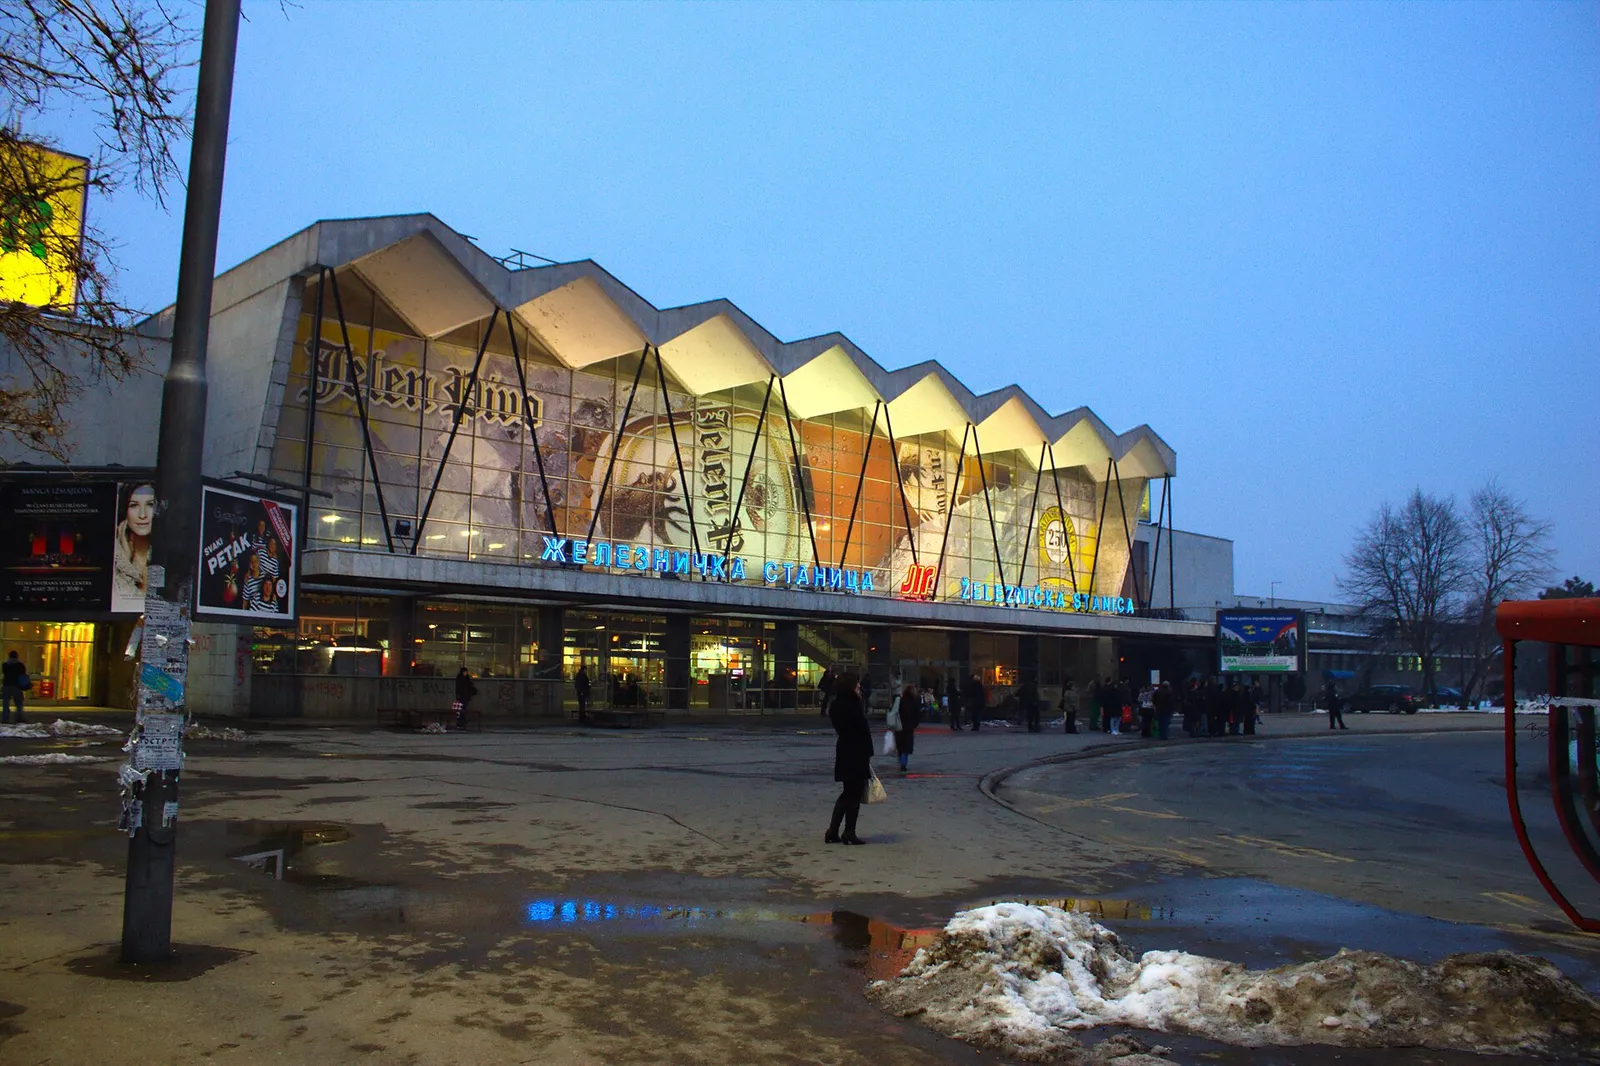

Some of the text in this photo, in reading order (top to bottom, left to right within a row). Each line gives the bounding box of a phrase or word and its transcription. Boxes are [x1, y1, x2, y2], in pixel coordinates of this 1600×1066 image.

[297, 337, 544, 429] Jelen Pivo
[690, 409, 730, 517] Jelen
[204, 532, 252, 576] SVAKI PETAK
[1048, 528, 1066, 548] 250
[541, 536, 875, 594] ЖЕЛЕЗНИЧКА СТАНИЦА
[961, 576, 1065, 609] ŽELEZNIČKA
[1072, 592, 1135, 614] STANICA
